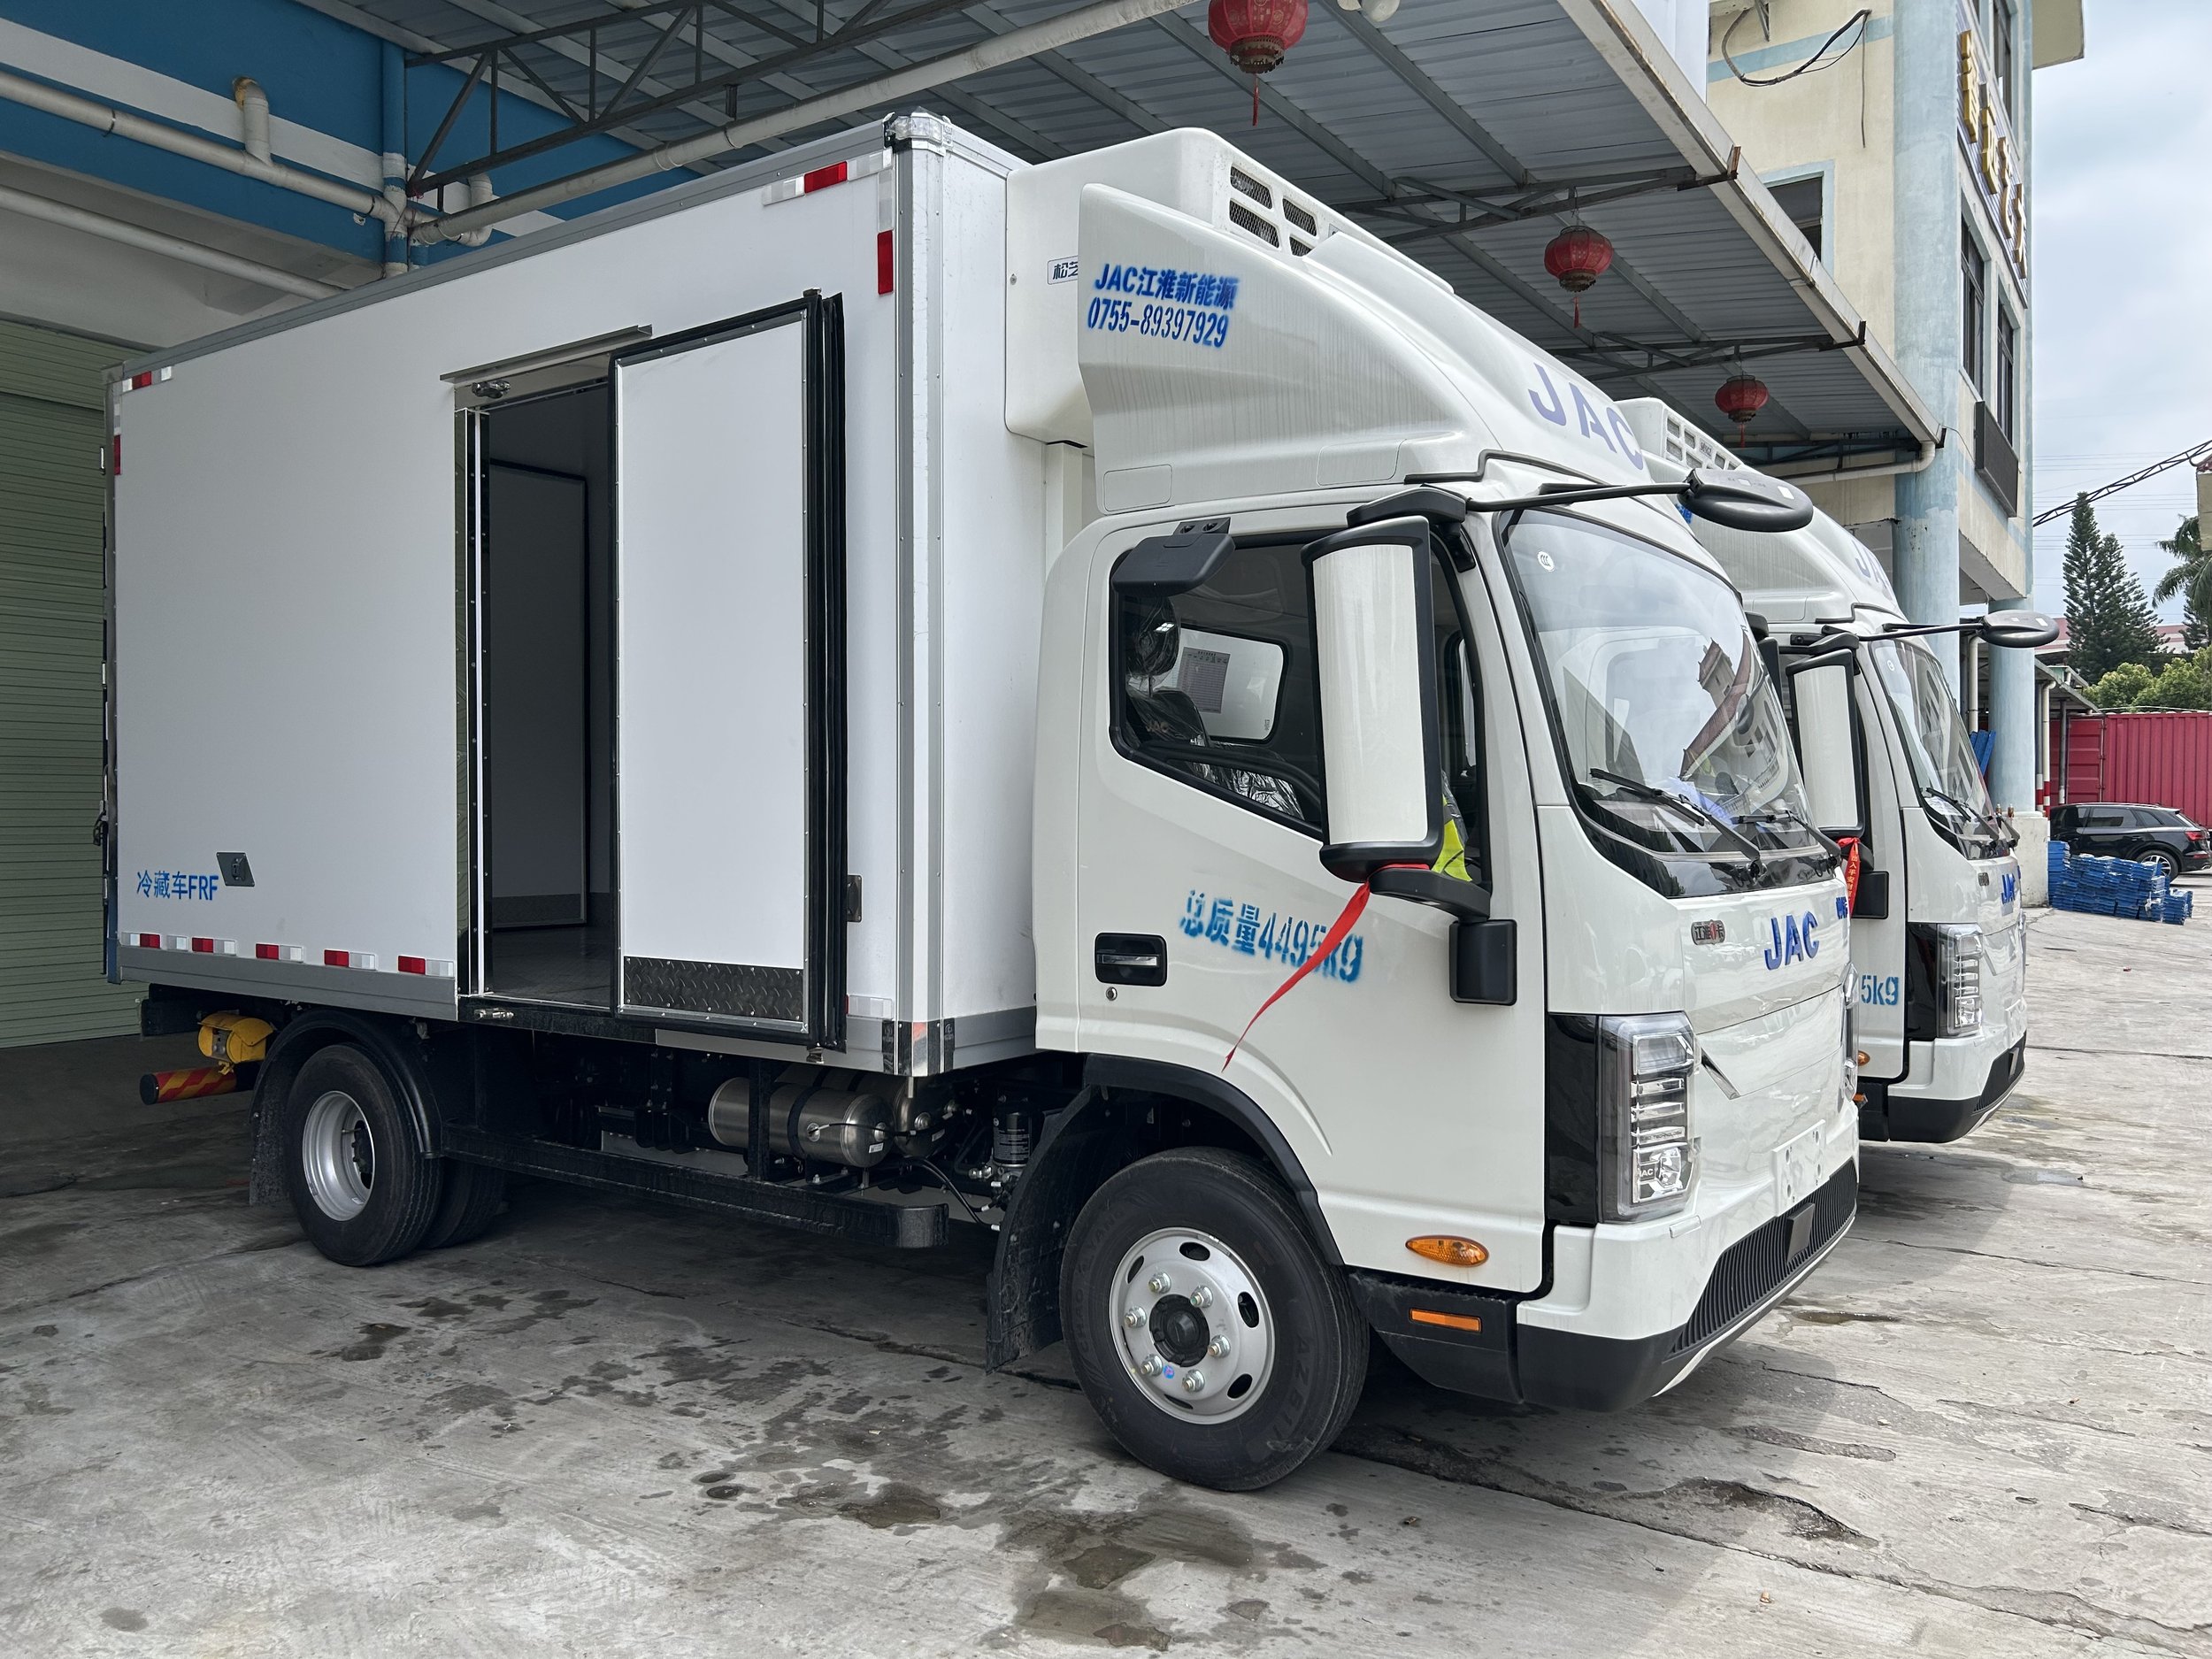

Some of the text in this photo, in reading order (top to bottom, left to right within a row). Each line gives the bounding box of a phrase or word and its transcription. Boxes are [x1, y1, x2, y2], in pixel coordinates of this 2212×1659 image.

[1094, 263, 1239, 310] JAC江淮新能源
[1087, 296, 1229, 348] 0755-89397929
[1528, 363, 1643, 471] JAC
[136, 870, 219, 901] 冷藏车FRF
[1764, 911, 1819, 971] JAC
[1861, 974, 1899, 1006] 5kg
